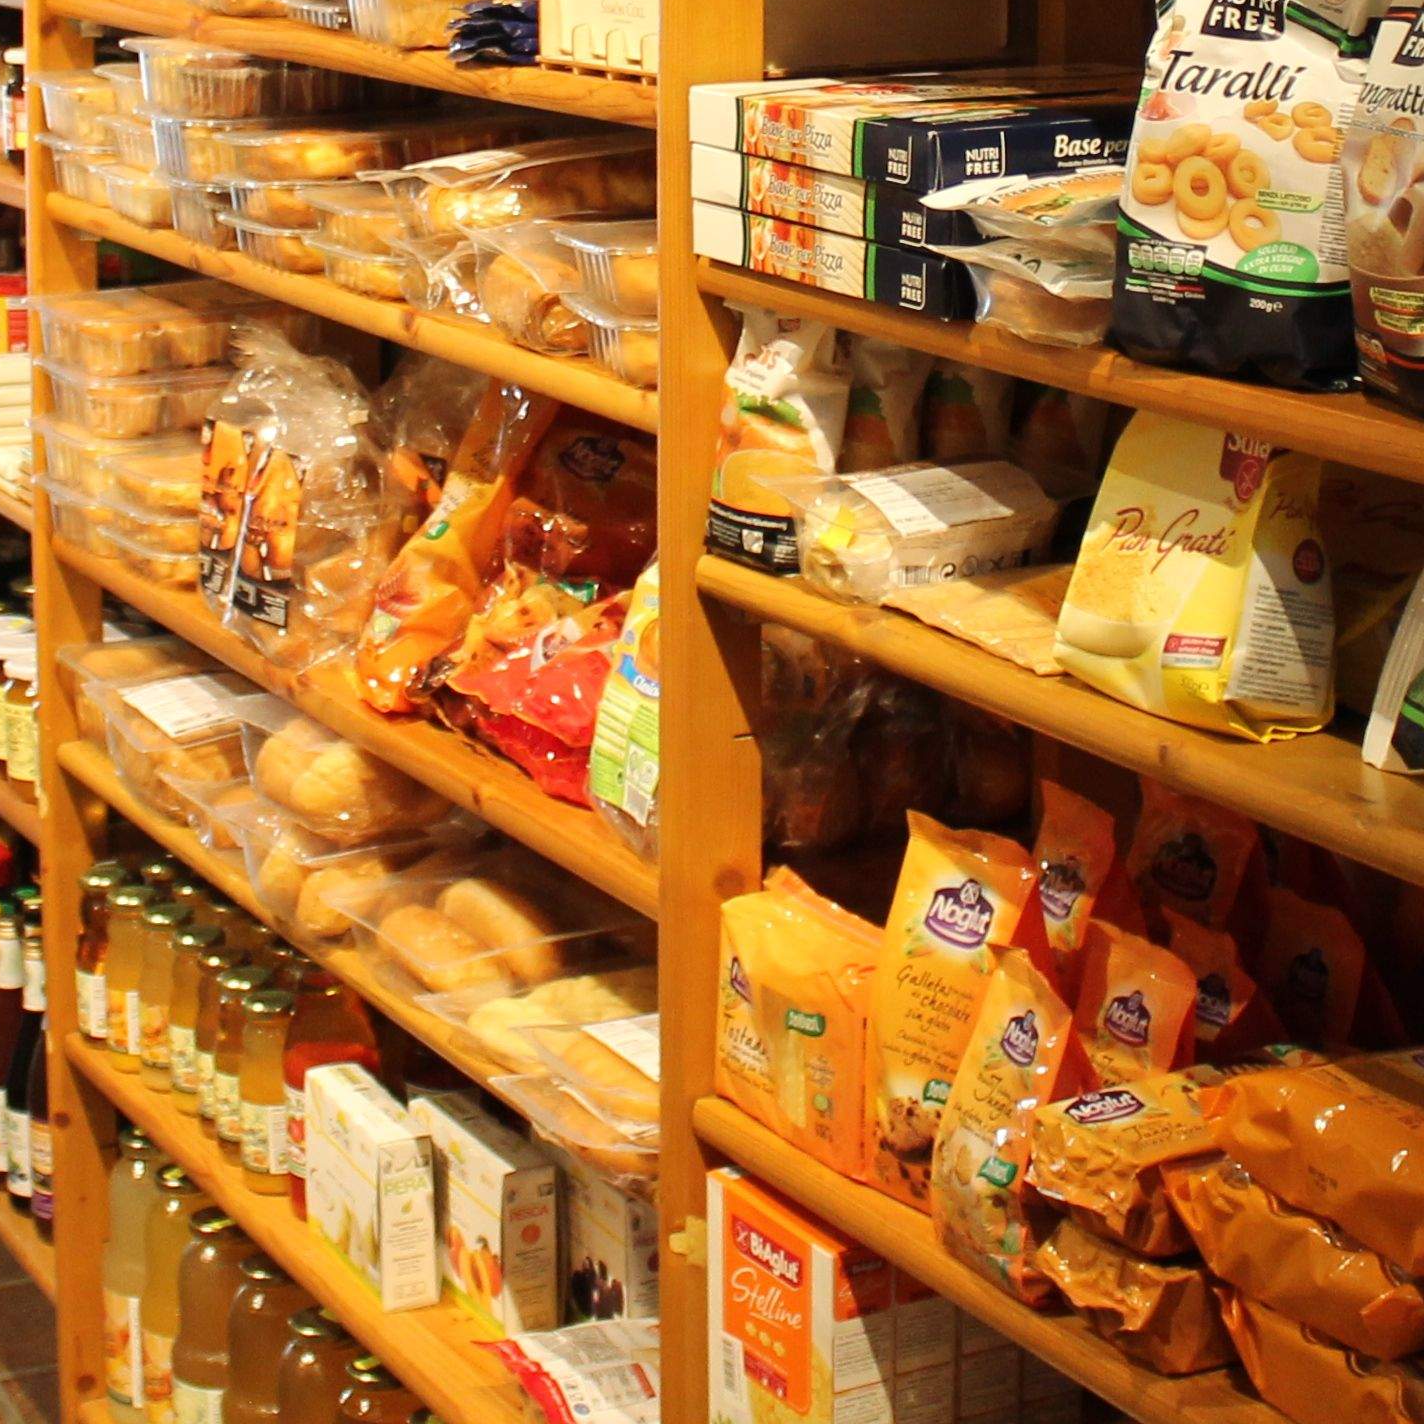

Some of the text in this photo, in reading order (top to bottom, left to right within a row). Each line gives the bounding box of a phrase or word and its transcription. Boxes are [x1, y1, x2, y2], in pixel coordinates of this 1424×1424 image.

[1209, 5, 1278, 36] FREE
[1159, 50, 1307, 102] Taralli
[804, 122, 833, 150] Pizza
[1054, 133, 1130, 159] Base per
[888, 148, 908, 163] NUTRI
[888, 161, 909, 176] FREE
[966, 148, 1000, 162] NUTRI
[966, 162, 1000, 176] FREE
[812, 181, 843, 209] Pizza
[901, 223, 923, 240] FREE
[813, 242, 844, 271] Pizza
[900, 287, 923, 303] FREE
[901, 274, 922, 290] NUTRI
[1104, 507, 1150, 553] Pan
[928, 893, 989, 938] Noglut
[1067, 1091, 1134, 1121] Noglut
[750, 1223, 801, 1285] BiAglut
[730, 1266, 803, 1330] Stelline
